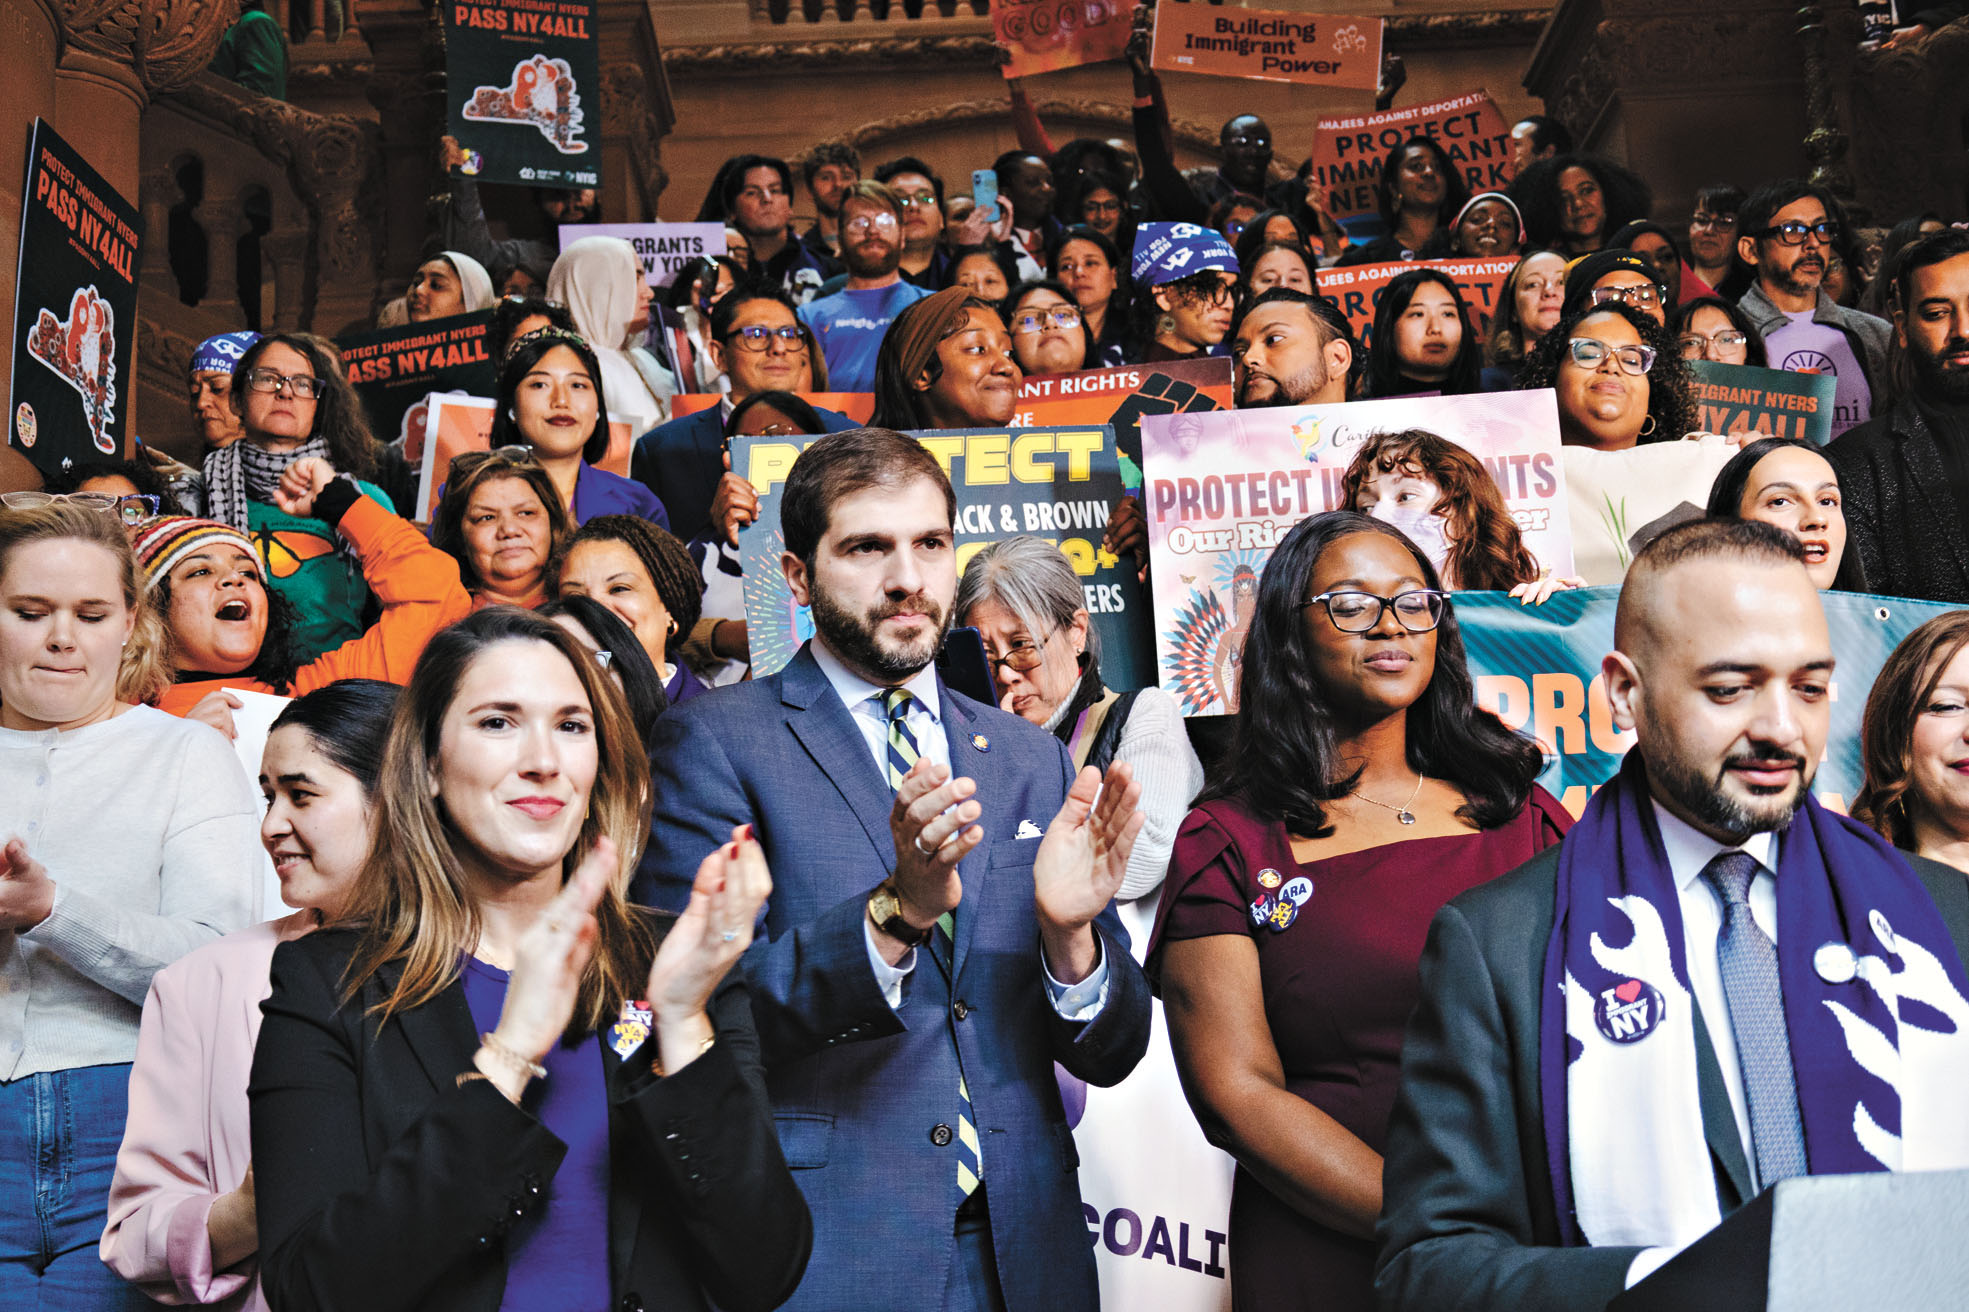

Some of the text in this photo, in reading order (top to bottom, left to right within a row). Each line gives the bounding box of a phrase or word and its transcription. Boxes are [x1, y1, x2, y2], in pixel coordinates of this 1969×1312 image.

[455, 5, 590, 39] PASS NY4ALL
[559, 4, 590, 16] NYERS
[1185, 33, 1297, 56] Immigrant
[1215, 17, 1316, 43] Building
[1262, 57, 1342, 75] Power
[1367, 109, 1419, 126] AGAINST
[1335, 111, 1482, 158] PROTECT
[41, 147, 139, 250] PROTECT IMMIGRANT NYERS
[37, 168, 134, 285] PASS NY4ALL
[382, 331, 447, 354] IMMIGRANT
[450, 324, 487, 341] NYERS
[397, 339, 490, 376] NY4ALL
[1060, 371, 1141, 395] RIGHTS
[1765, 391, 1818, 413] NYERS
[747, 431, 1104, 496] PTECT
[1153, 469, 1312, 523] PROTECT
[1000, 504, 1019, 532] &
[1022, 500, 1110, 531] BROWN
[1167, 526, 1235, 555] Our
[1282, 882, 1308, 900] ARA
[1601, 988, 1621, 1012] I
[1609, 1004, 1649, 1040] NY
